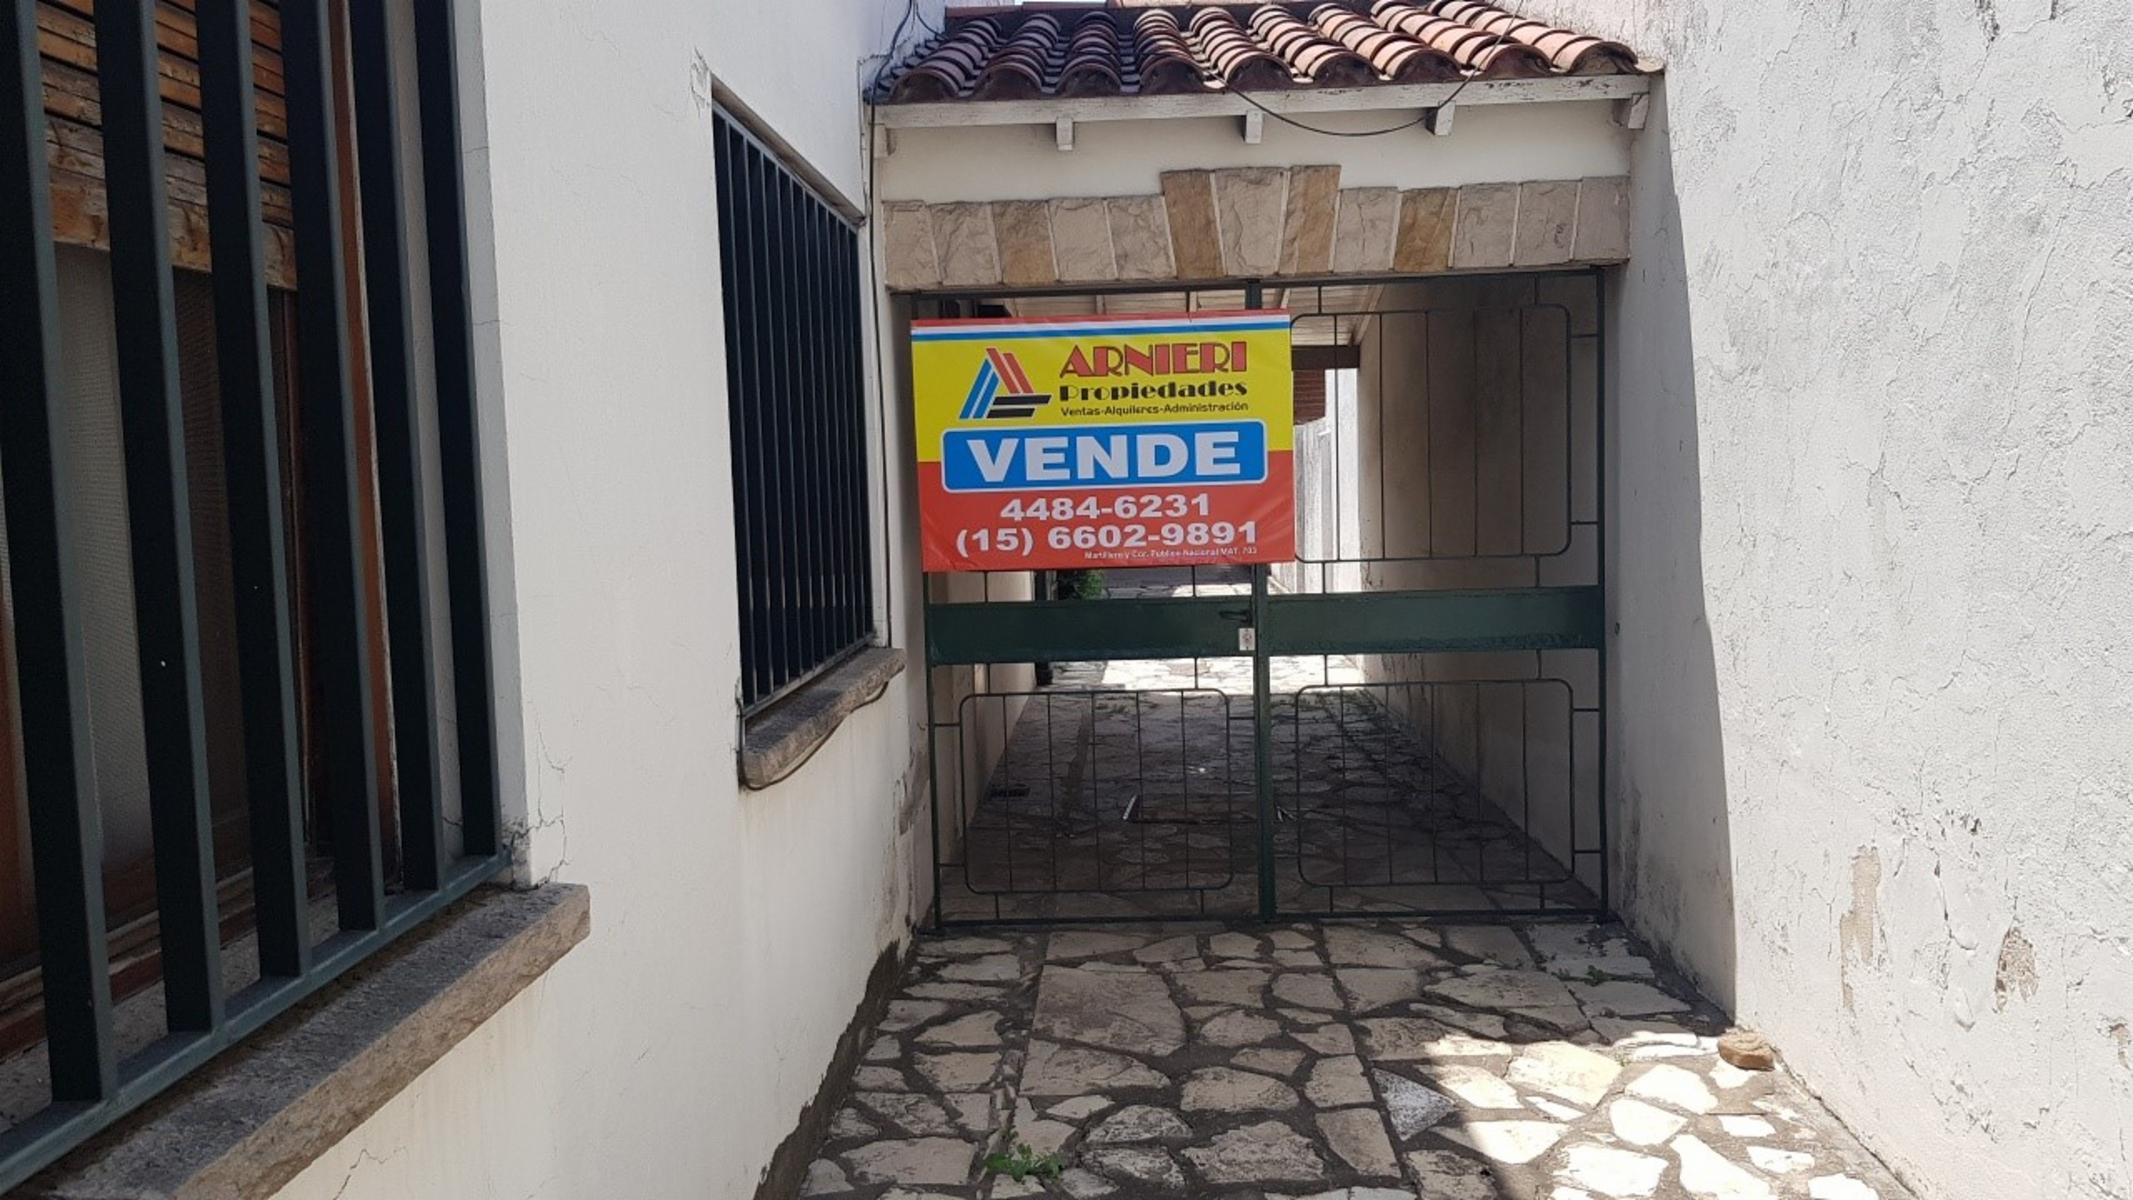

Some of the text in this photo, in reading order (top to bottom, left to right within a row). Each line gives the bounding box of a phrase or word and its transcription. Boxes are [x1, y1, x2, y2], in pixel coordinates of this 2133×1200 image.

[1059, 341, 1247, 378] ARNIERI
[1059, 379, 1248, 402] Propiedades
[1060, 402, 1248, 417] Ventas-Alquileres-Administración
[966, 431, 1240, 483] VENDE
[1000, 493, 1209, 522] 4484-6231
[956, 521, 1257, 558] (15) 6602-9891
